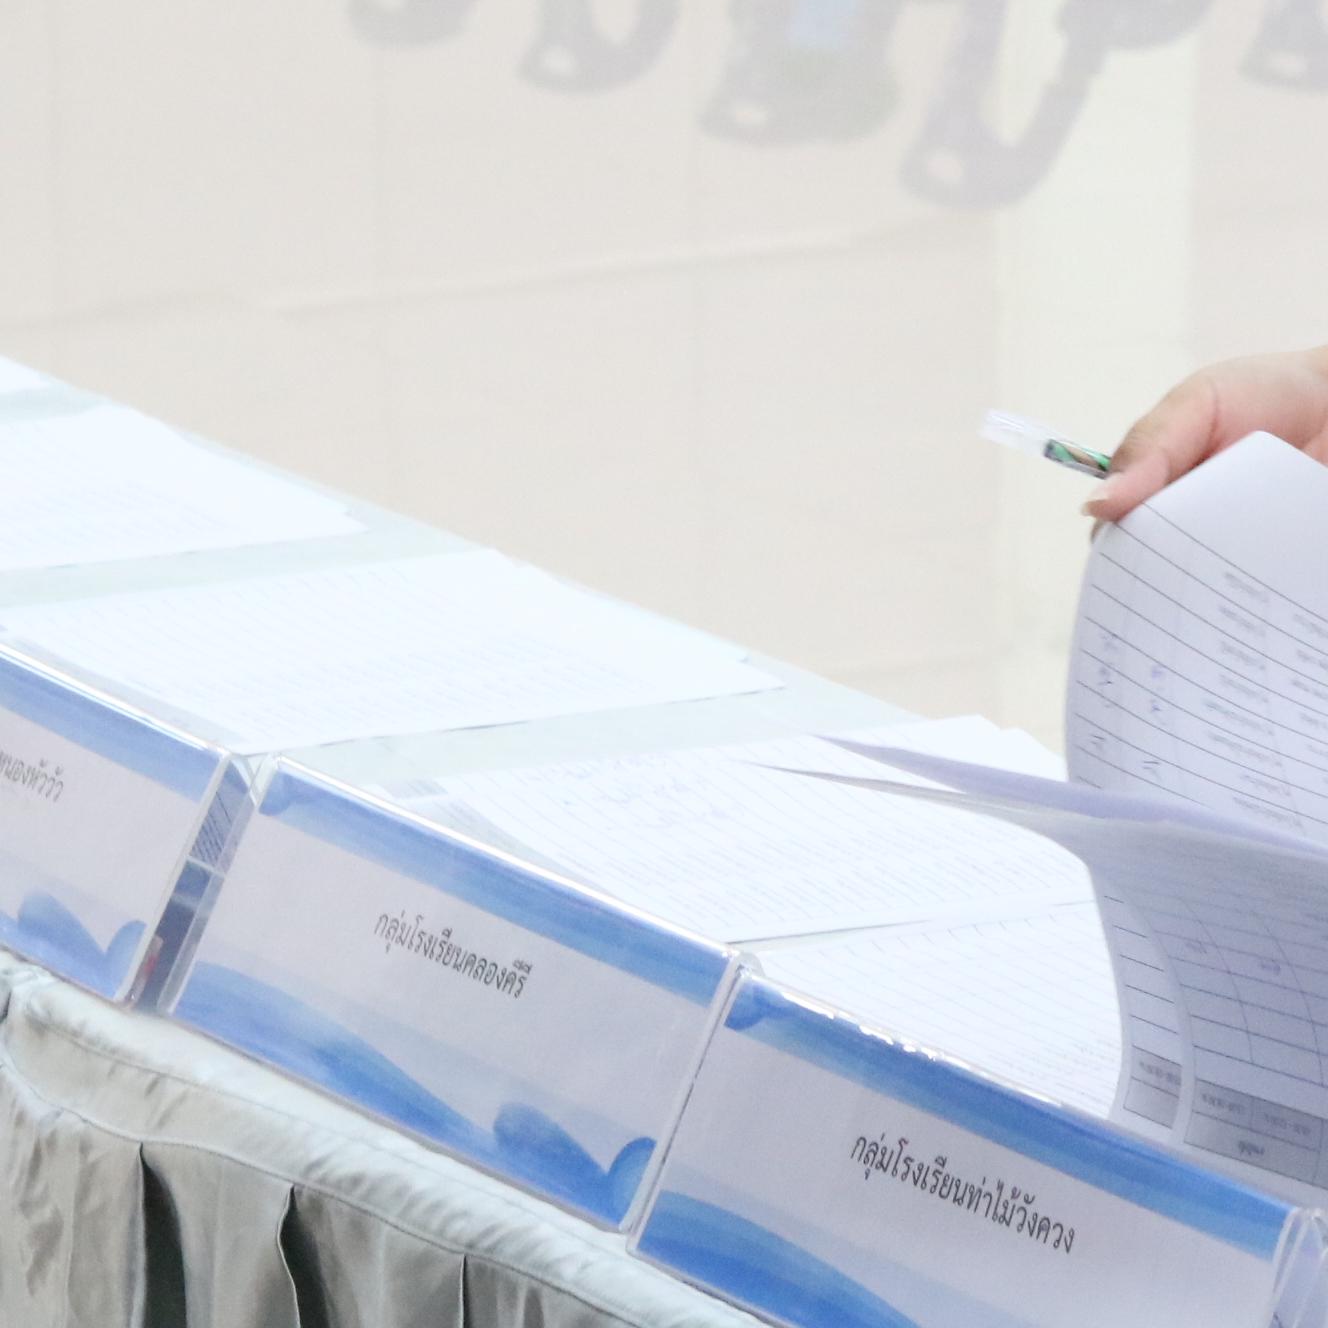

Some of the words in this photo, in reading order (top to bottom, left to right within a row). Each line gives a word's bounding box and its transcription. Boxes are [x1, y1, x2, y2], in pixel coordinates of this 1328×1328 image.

[373, 910, 533, 999] กลุ่มโรงเรียนคลองคีรี
[850, 1133, 1075, 1254] กลุ่มโรงเรียนท่าไม้วังควง
